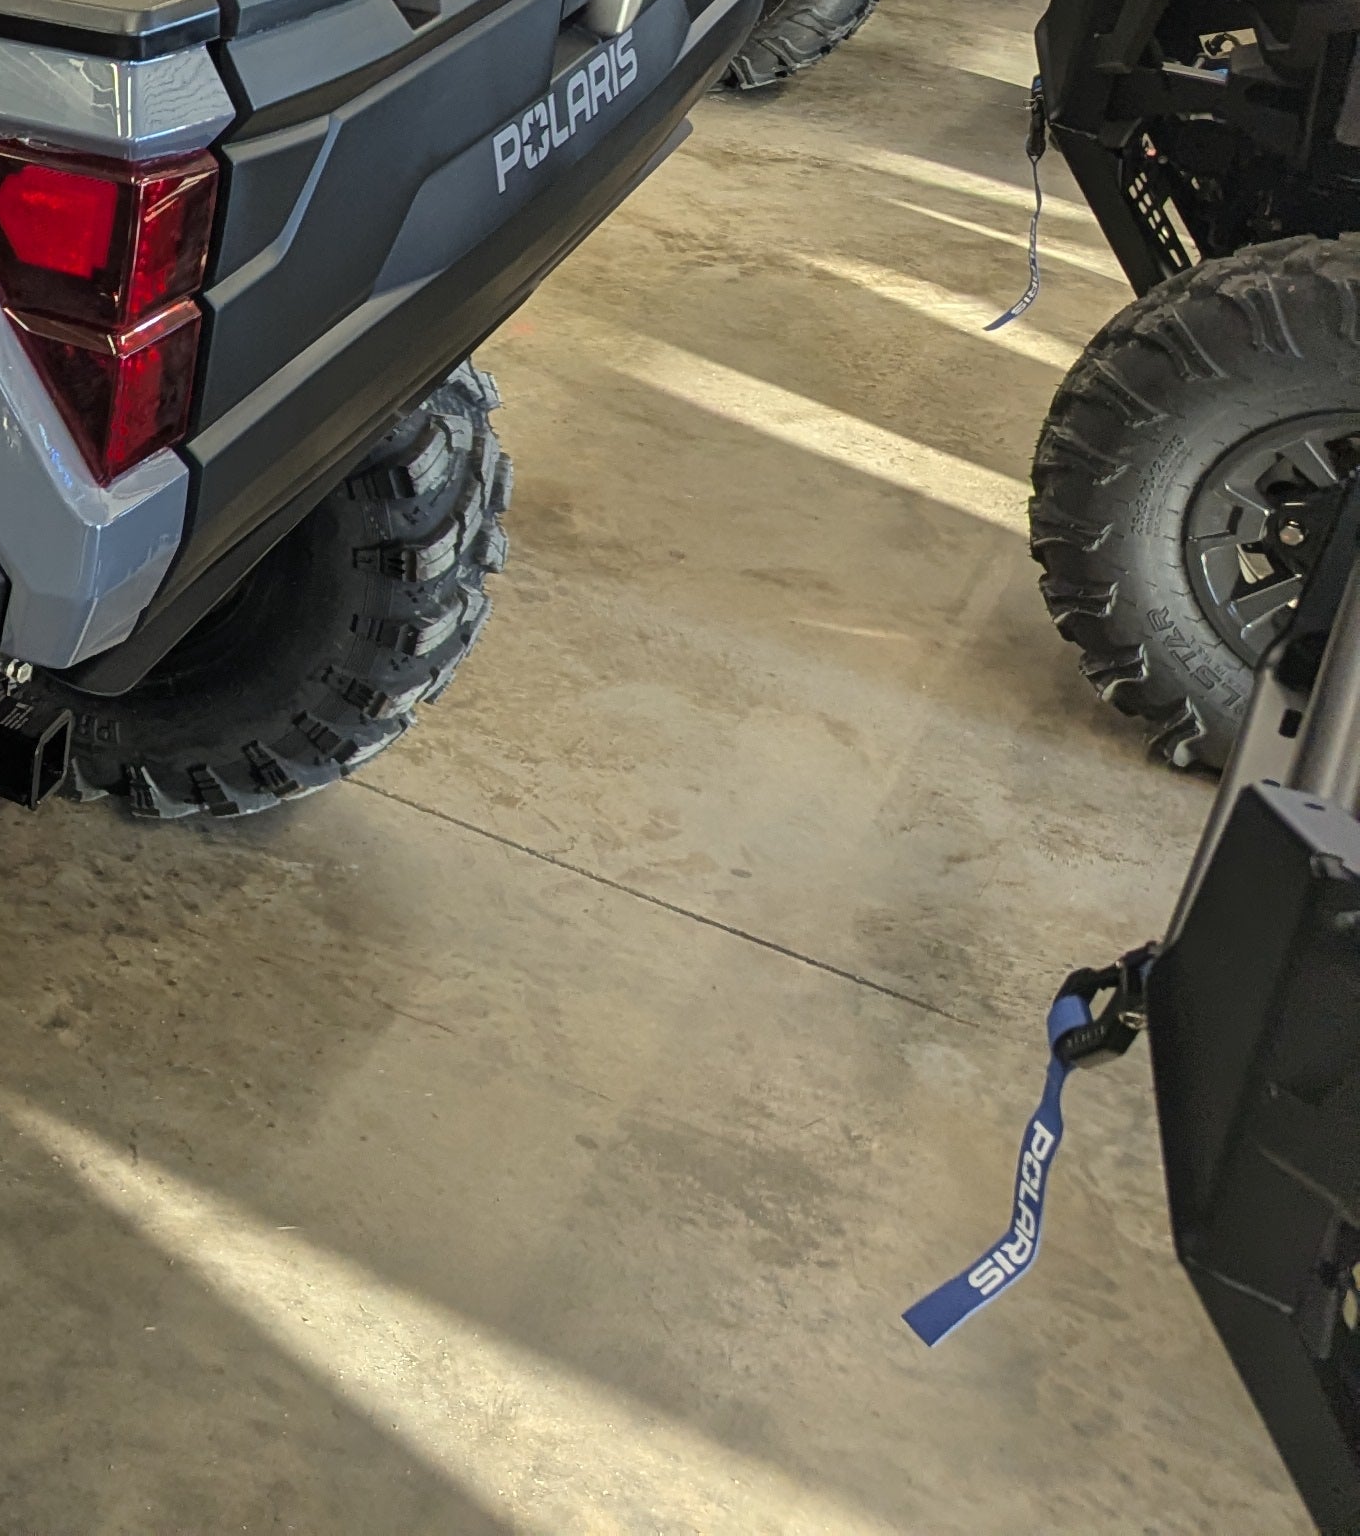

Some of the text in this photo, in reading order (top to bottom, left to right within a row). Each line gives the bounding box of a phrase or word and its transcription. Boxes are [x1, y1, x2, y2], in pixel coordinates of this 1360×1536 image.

[493, 27, 639, 195] POLARIS
[1147, 606, 1243, 708] LSTAR
[967, 1119, 1056, 1296] POLARIS
